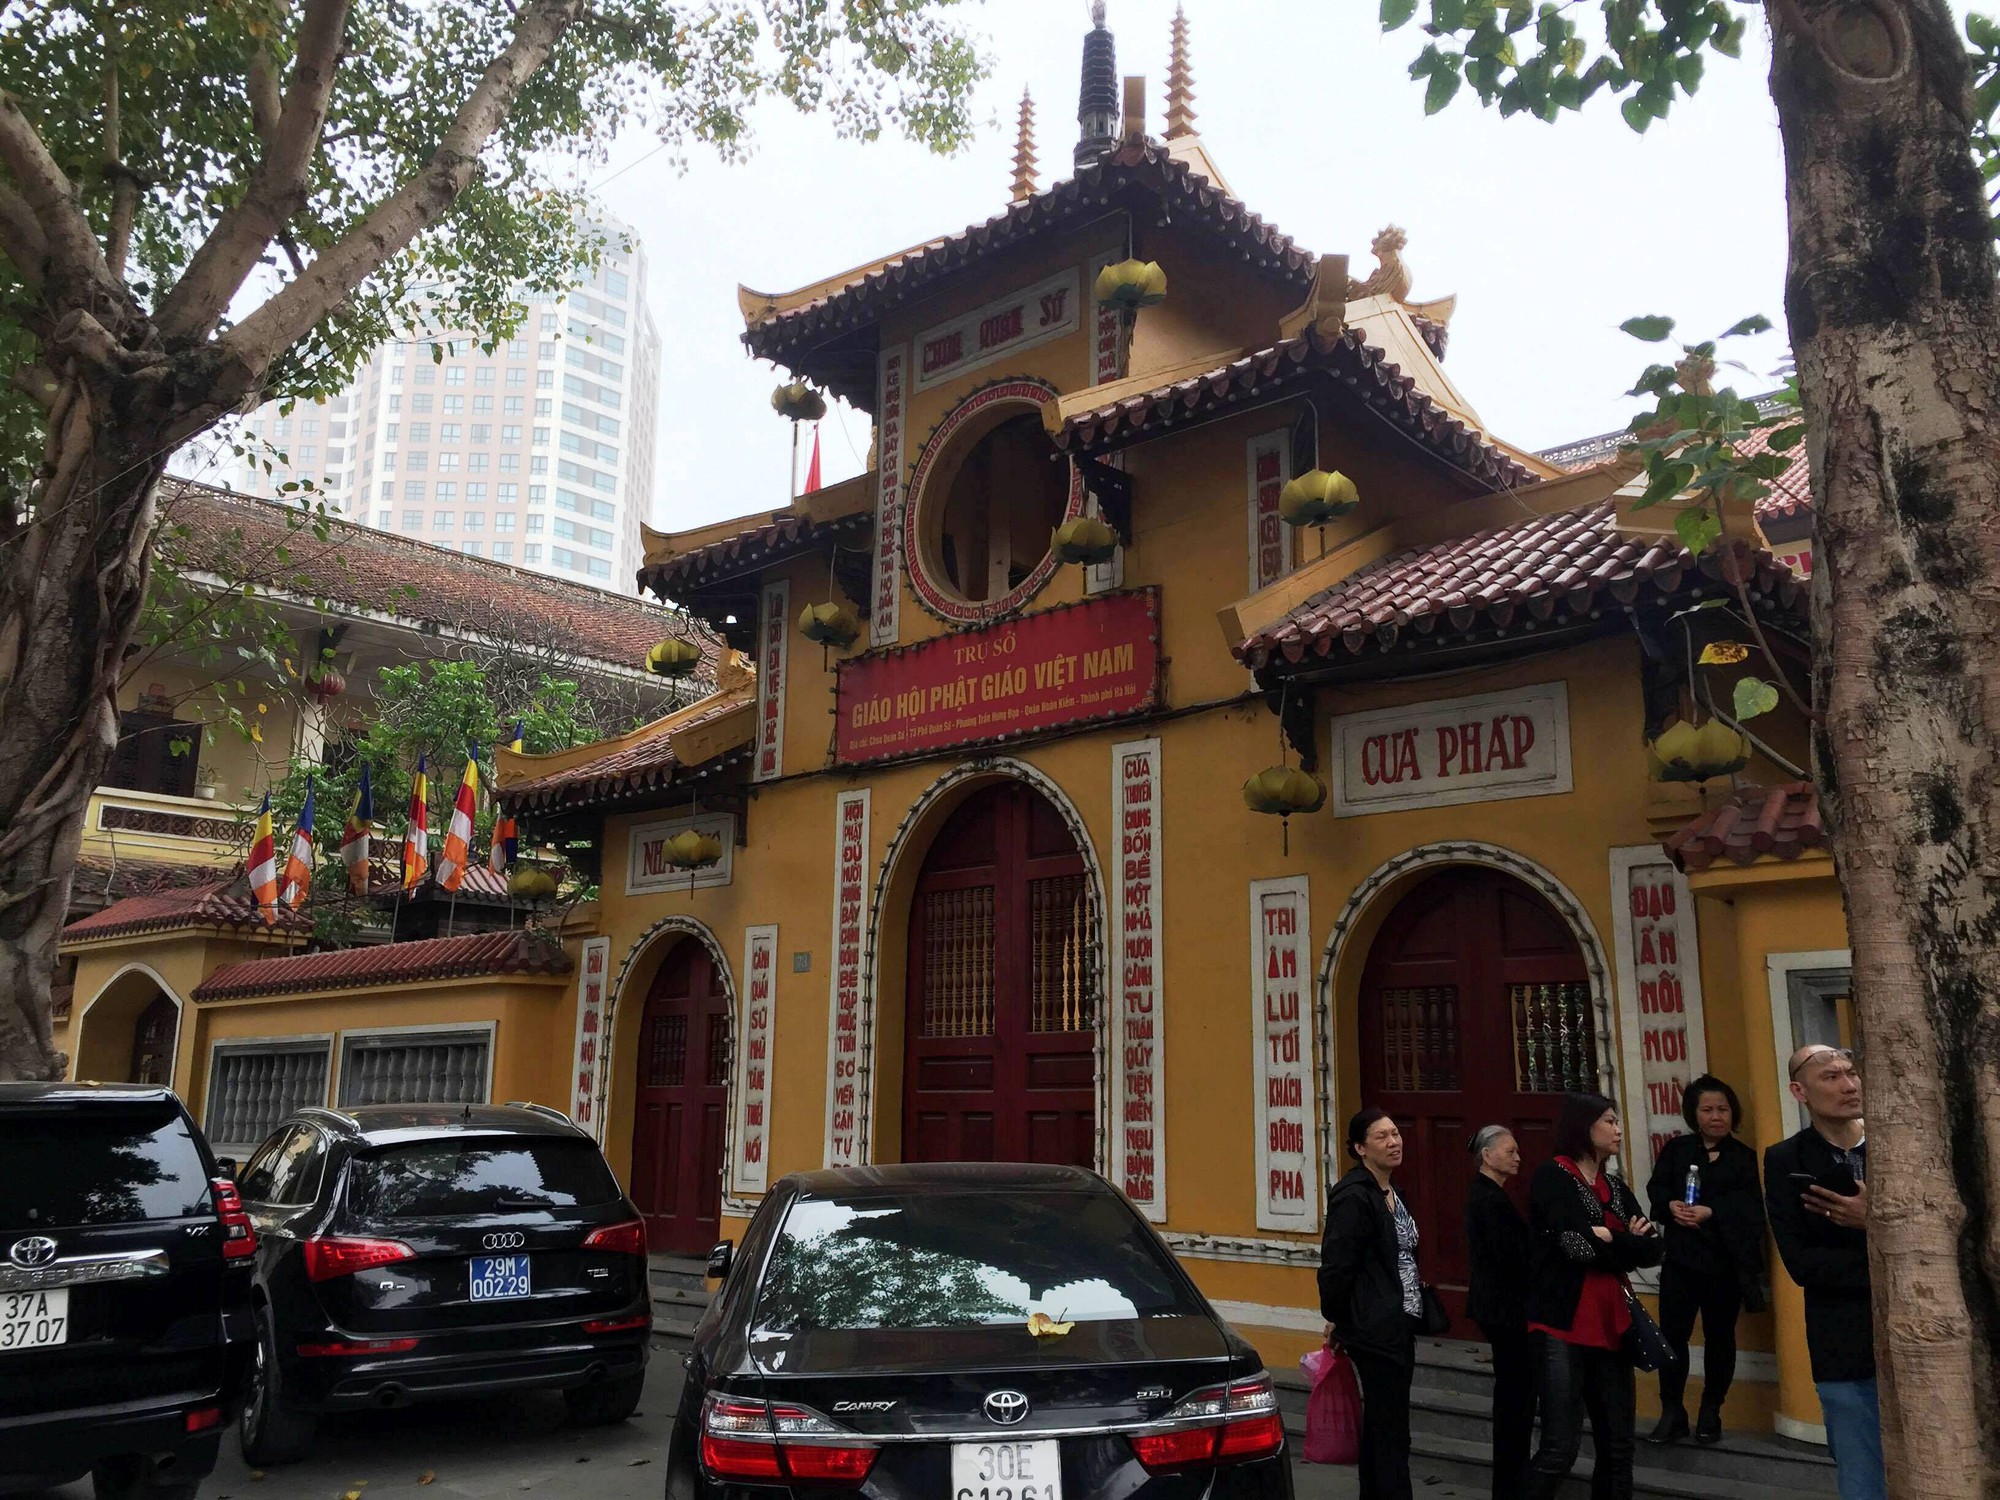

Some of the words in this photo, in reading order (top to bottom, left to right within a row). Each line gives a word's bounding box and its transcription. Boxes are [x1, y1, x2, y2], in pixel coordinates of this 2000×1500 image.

[953, 642, 989, 666] TRỤ
[993, 630, 1017, 657] SỞ
[852, 693, 891, 728] GIÁO
[897, 687, 926, 722] HỘI
[930, 675, 977, 712] PHẬT
[981, 664, 1027, 702] GIÁO
[1034, 655, 1077, 691] VIỆT
[1083, 643, 1134, 680] NAM
[1437, 714, 1535, 778] PHÁP
[1124, 828, 1151, 855] BỐN
[1633, 884, 1676, 921] ĐẠO
[1125, 991, 1153, 1014] TU
[1268, 992, 1299, 1022] LUI
[1269, 1071, 1302, 1107] KHÁCH
[1127, 1128, 1153, 1151] NGU
[1270, 1117, 1304, 1154] ĐÔNG
[1271, 1170, 1305, 1202] PHA
[484, 1258, 516, 1278] 29M
[473, 1276, 528, 1299] 002.29
[6, 1293, 49, 1320] 37A
[833, 1400, 897, 1412] CAMRY
[978, 1444, 1035, 1482] 30E
